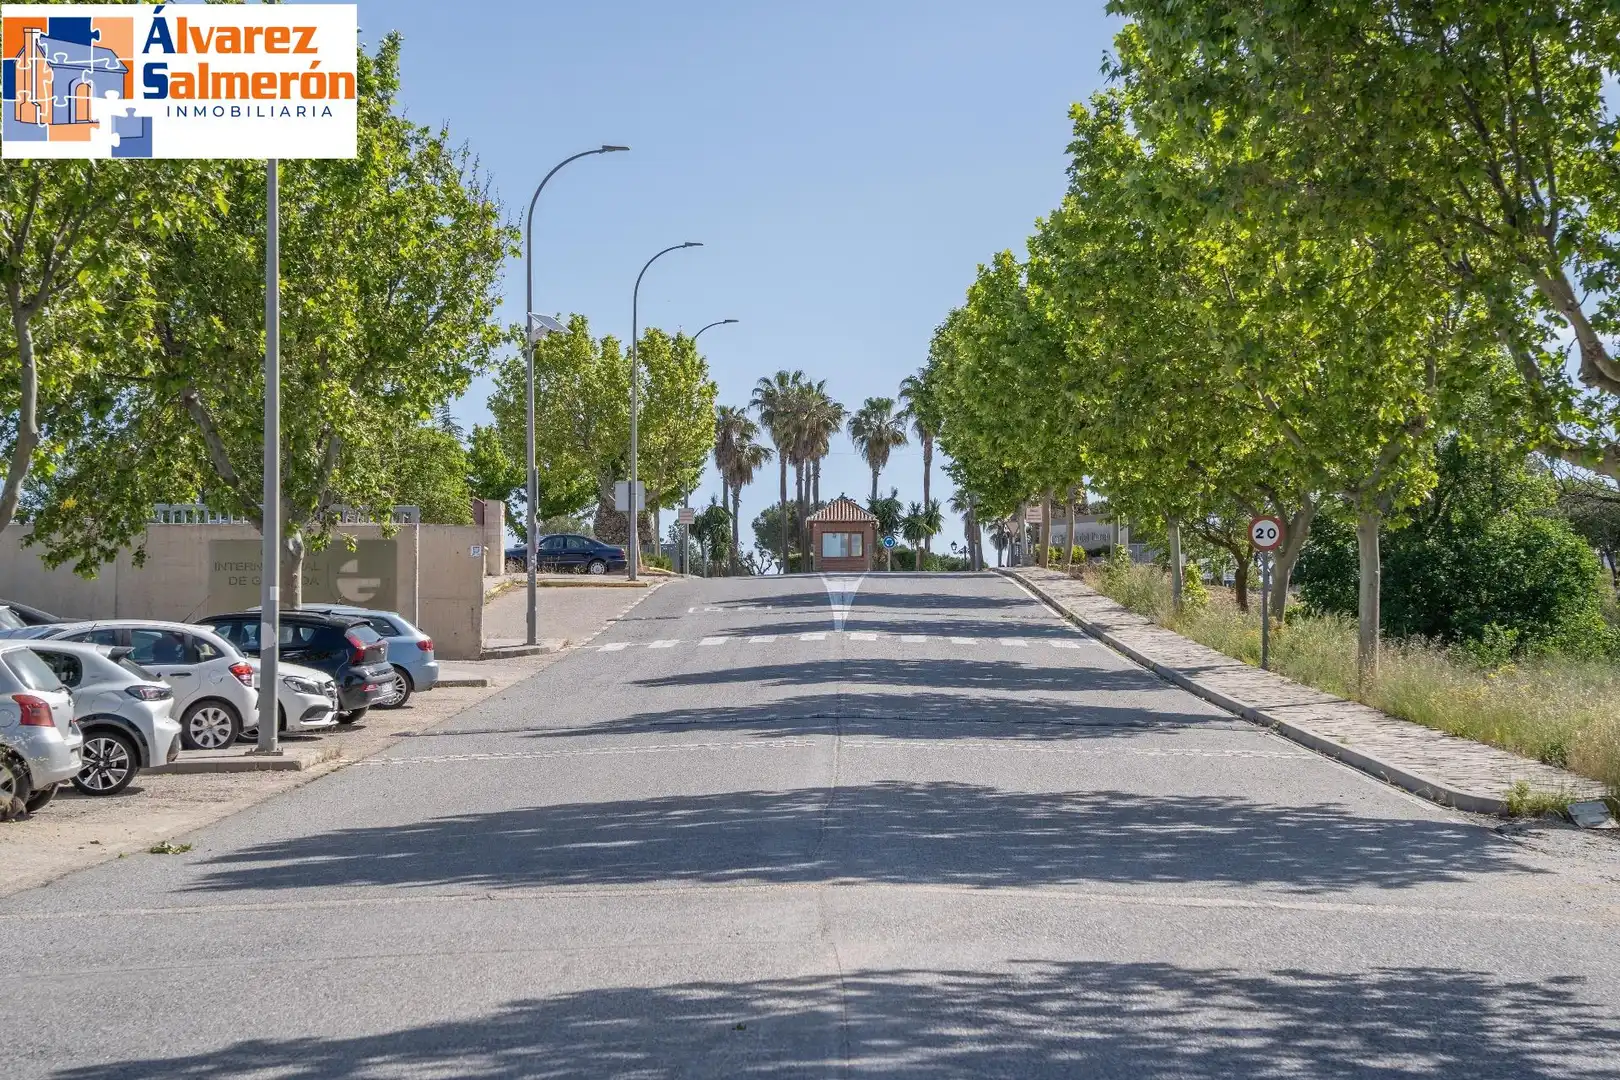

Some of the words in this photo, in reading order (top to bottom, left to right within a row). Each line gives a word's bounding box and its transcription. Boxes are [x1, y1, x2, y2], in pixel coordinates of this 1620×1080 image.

[1255, 528, 1277, 539] 20
[213, 561, 322, 572] INTERNAL
[228, 575, 248, 586] DE
